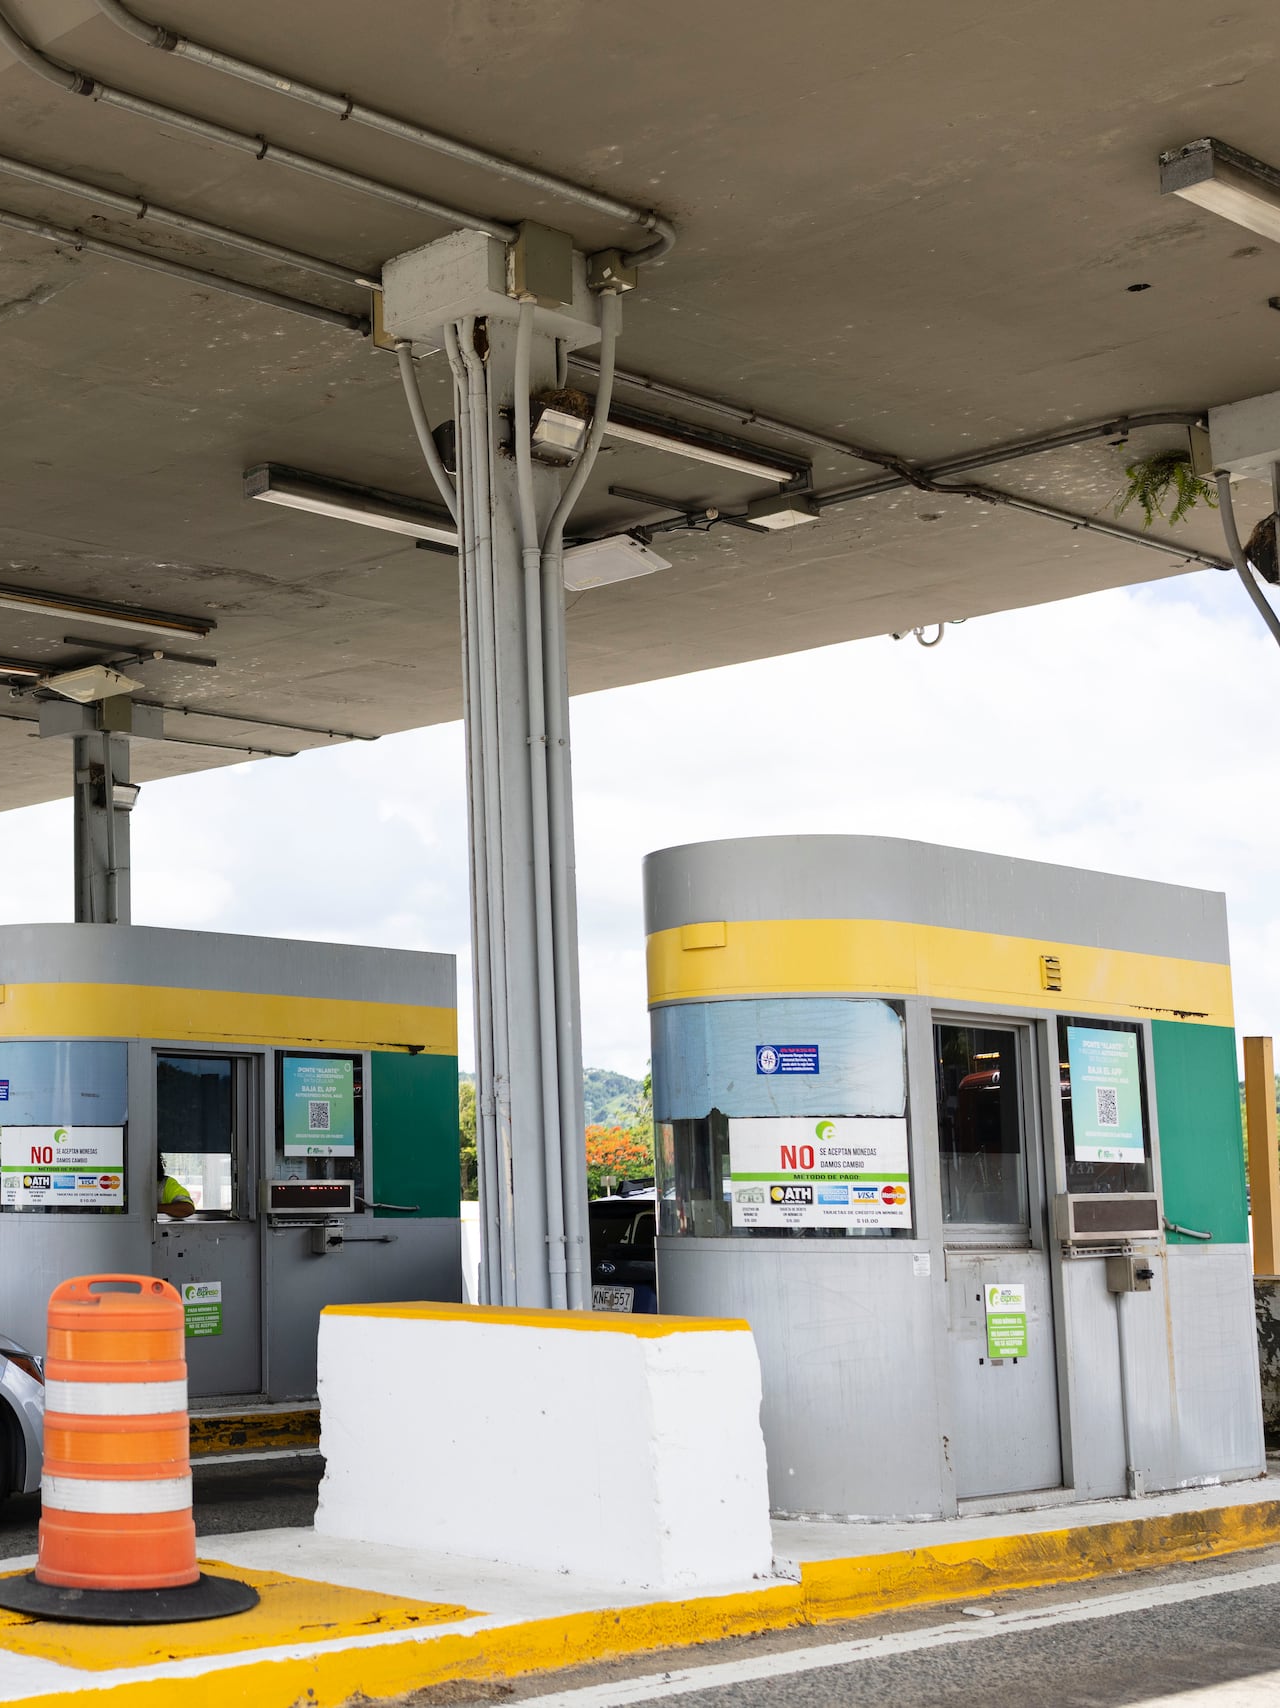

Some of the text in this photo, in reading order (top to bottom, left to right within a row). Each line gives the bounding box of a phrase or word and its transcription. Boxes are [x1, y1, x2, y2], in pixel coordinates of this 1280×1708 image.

[31, 1146, 52, 1164] NO
[780, 1145, 814, 1170] NO
[852, 1148, 877, 1156] MONEDAS
[34, 1177, 49, 1186] ATH
[785, 1187, 812, 1200] ATH
[615, 1292, 630, 1305] 557
